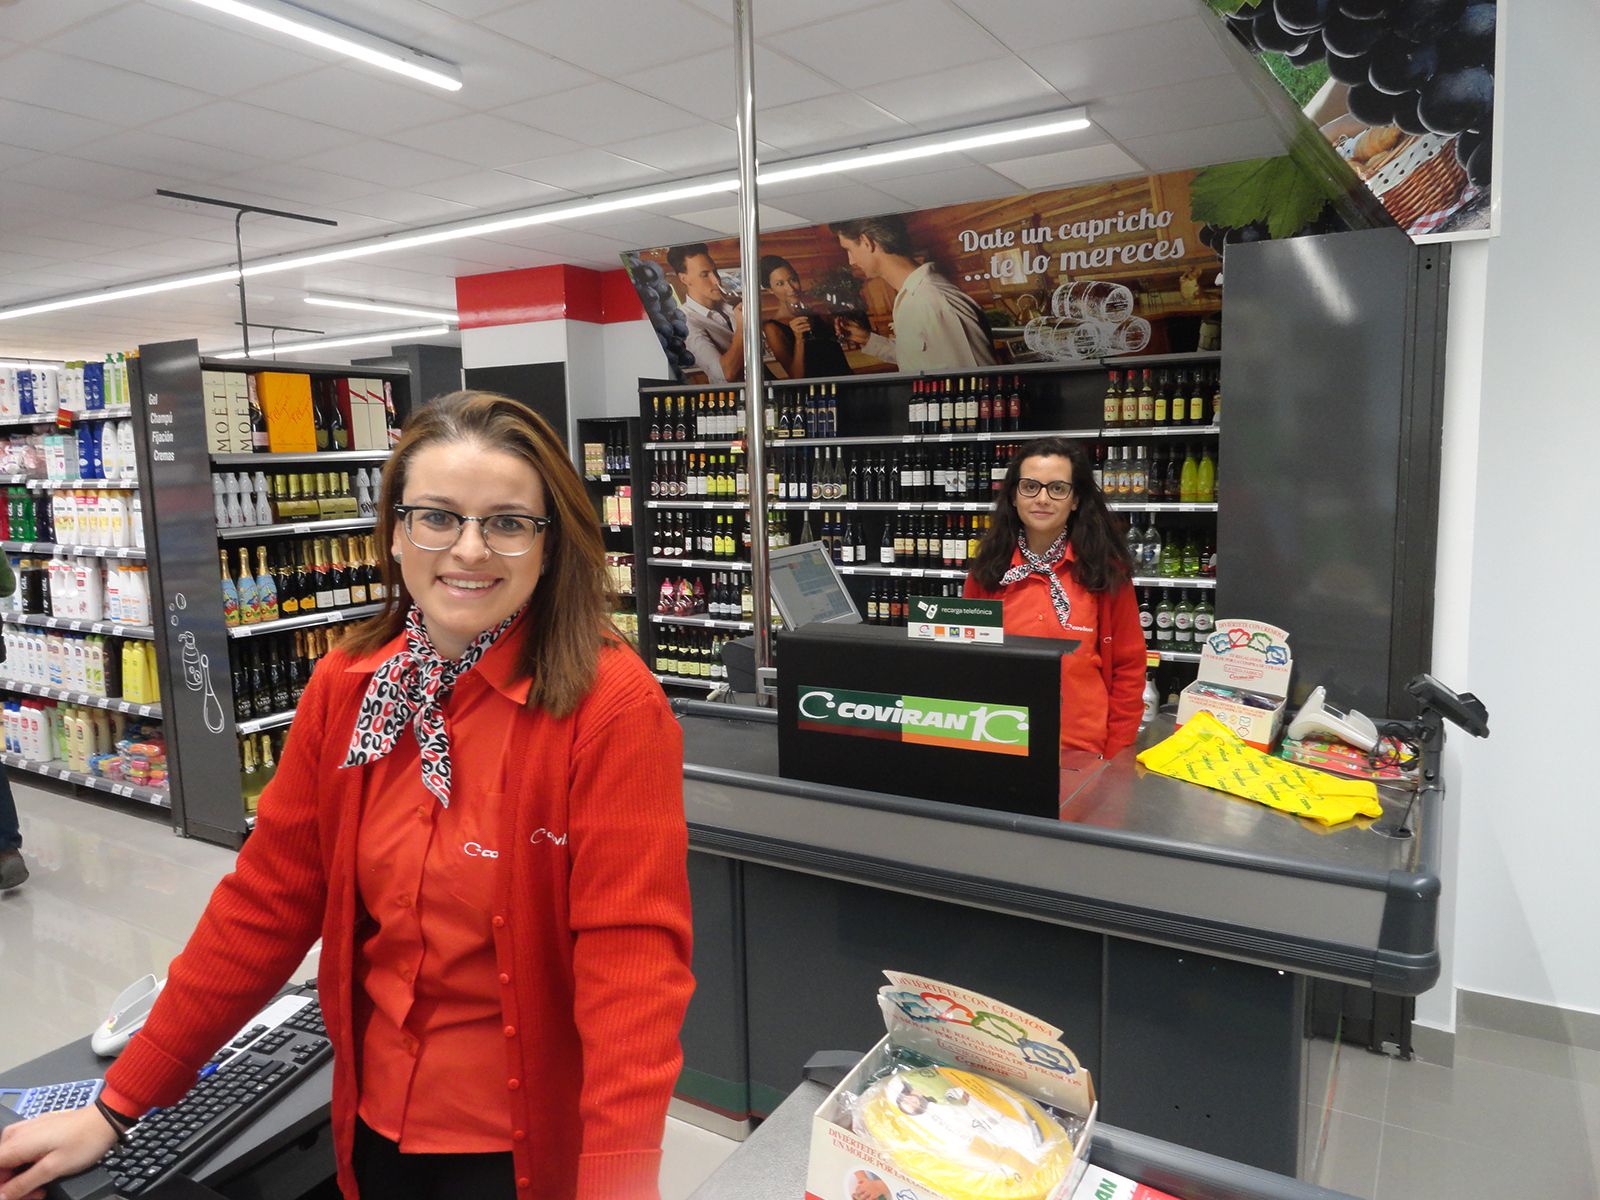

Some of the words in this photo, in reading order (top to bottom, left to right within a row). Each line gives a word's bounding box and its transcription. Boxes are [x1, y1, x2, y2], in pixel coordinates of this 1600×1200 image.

[958, 228, 1015, 252] Date
[1022, 226, 1053, 244] un
[1058, 207, 1174, 244] capricho
[1023, 250, 1051, 275] lo
[1060, 237, 1185, 271] mereces
[148, 393, 158, 405] Gel
[150, 411, 173, 426] Champú
[152, 430, 174, 445] Fijación
[153, 449, 175, 461] Cremas
[941, 607, 962, 615] recarga
[963, 608, 993, 616] telefónica
[991, 1003, 1053, 1037] CREMOSA
